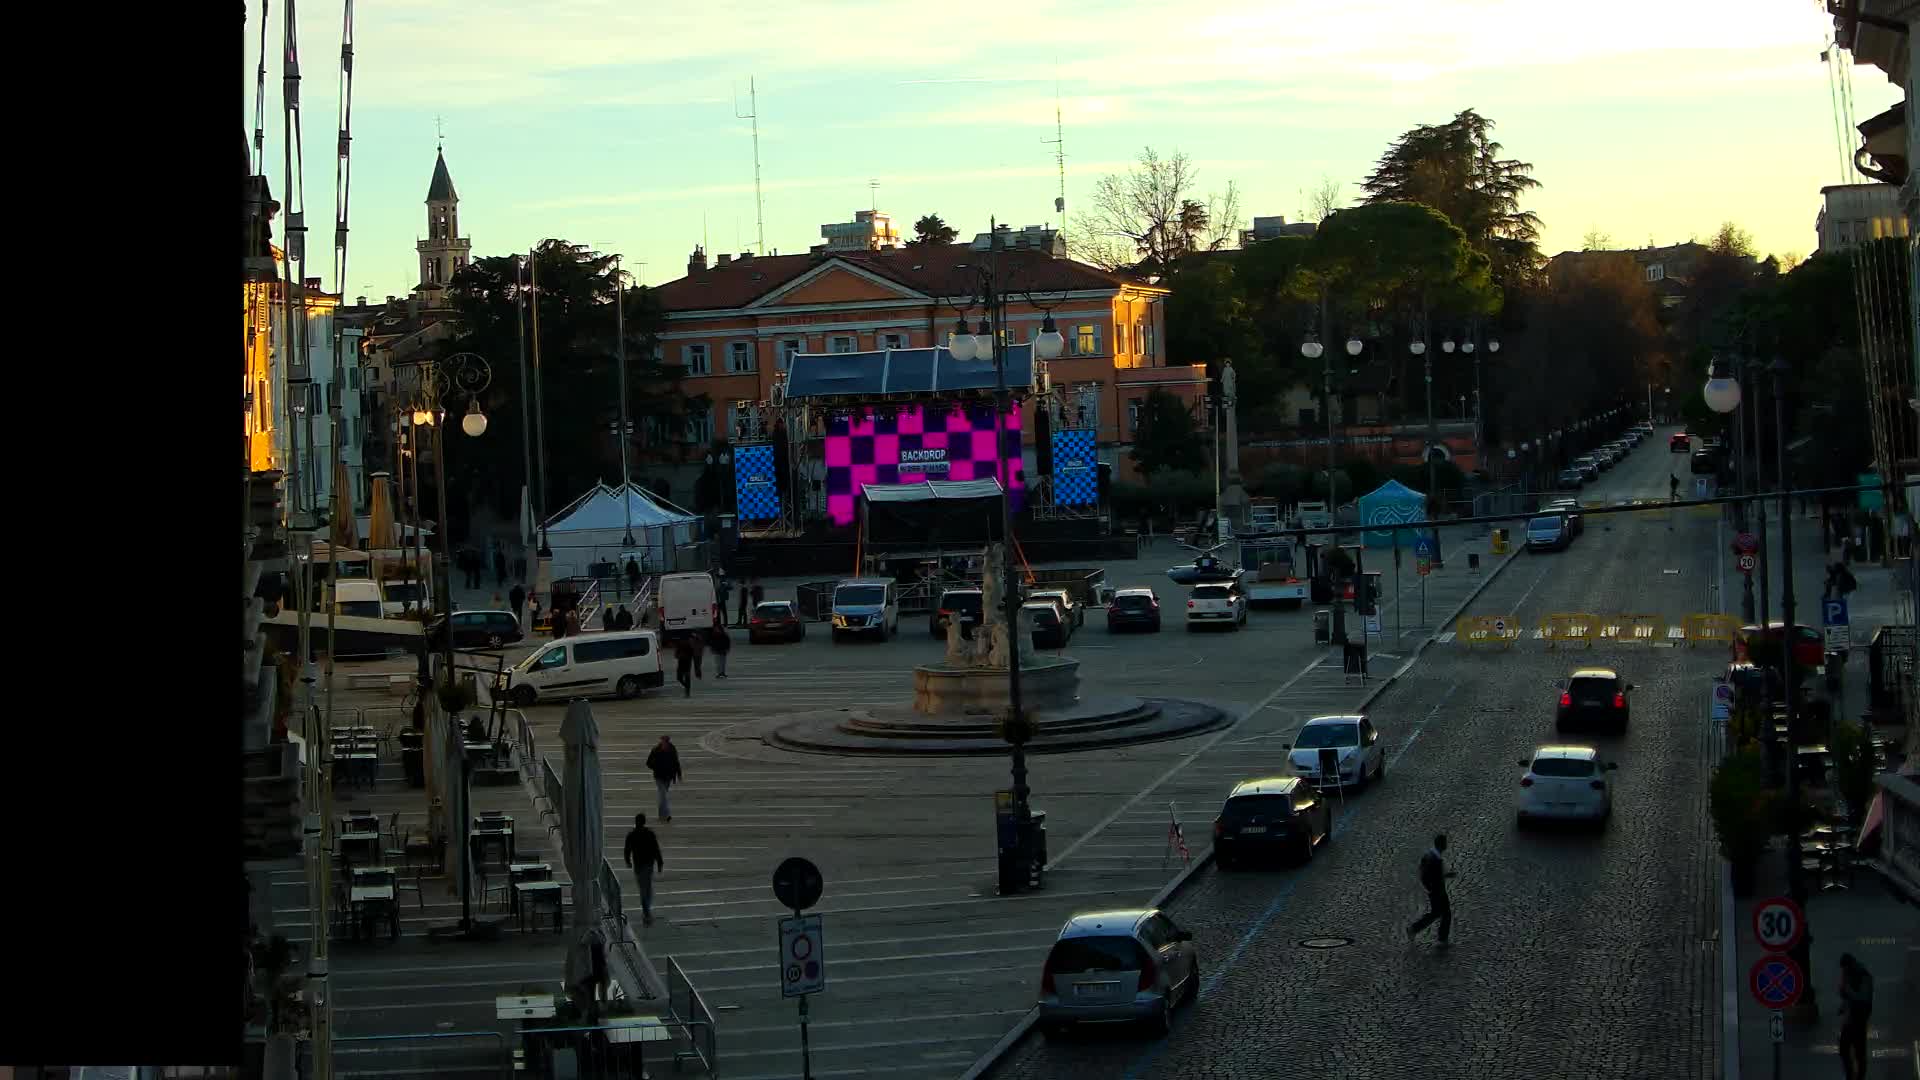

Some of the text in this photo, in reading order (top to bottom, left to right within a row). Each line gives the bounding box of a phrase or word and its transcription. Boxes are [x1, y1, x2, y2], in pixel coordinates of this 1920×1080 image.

[901, 449, 946, 461] BACKDROP
[1742, 558, 1753, 567] 20
[1826, 602, 1842, 623] P
[1763, 912, 1791, 938] 30
